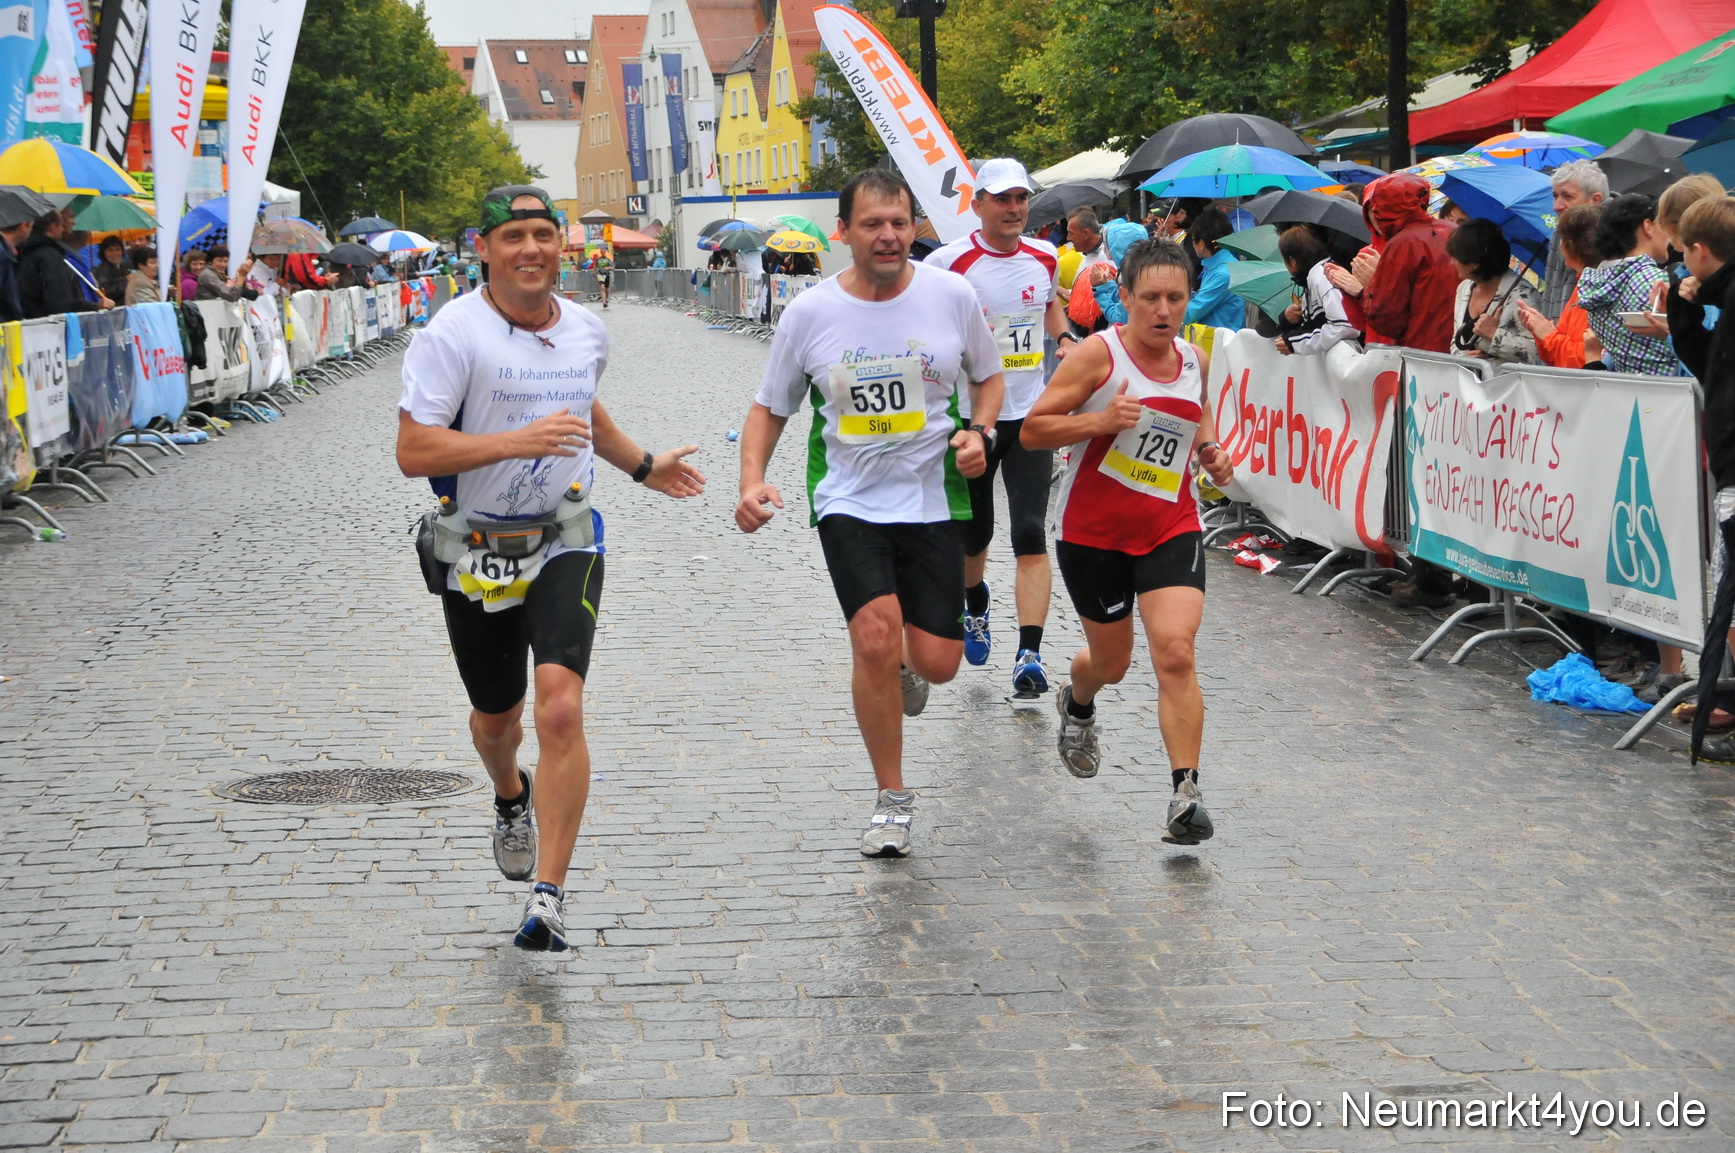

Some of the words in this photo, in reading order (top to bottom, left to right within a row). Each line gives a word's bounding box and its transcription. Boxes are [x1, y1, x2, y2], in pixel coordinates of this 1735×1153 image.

[179, 0, 200, 53] BK
[252, 24, 274, 87] BKK
[171, 62, 195, 149] Audi
[242, 94, 263, 166] Audi
[1008, 329, 1031, 352] 14
[498, 367, 516, 379] 18.
[519, 366, 588, 381] Johannesbad
[1004, 357, 1034, 368] Stephan
[850, 380, 906, 413] 530
[507, 412, 516, 422] 6.
[869, 418, 892, 434] Sigi
[1134, 431, 1179, 467] 129
[1215, 368, 1359, 511] Oberbank
[1130, 465, 1158, 484] Lydia
